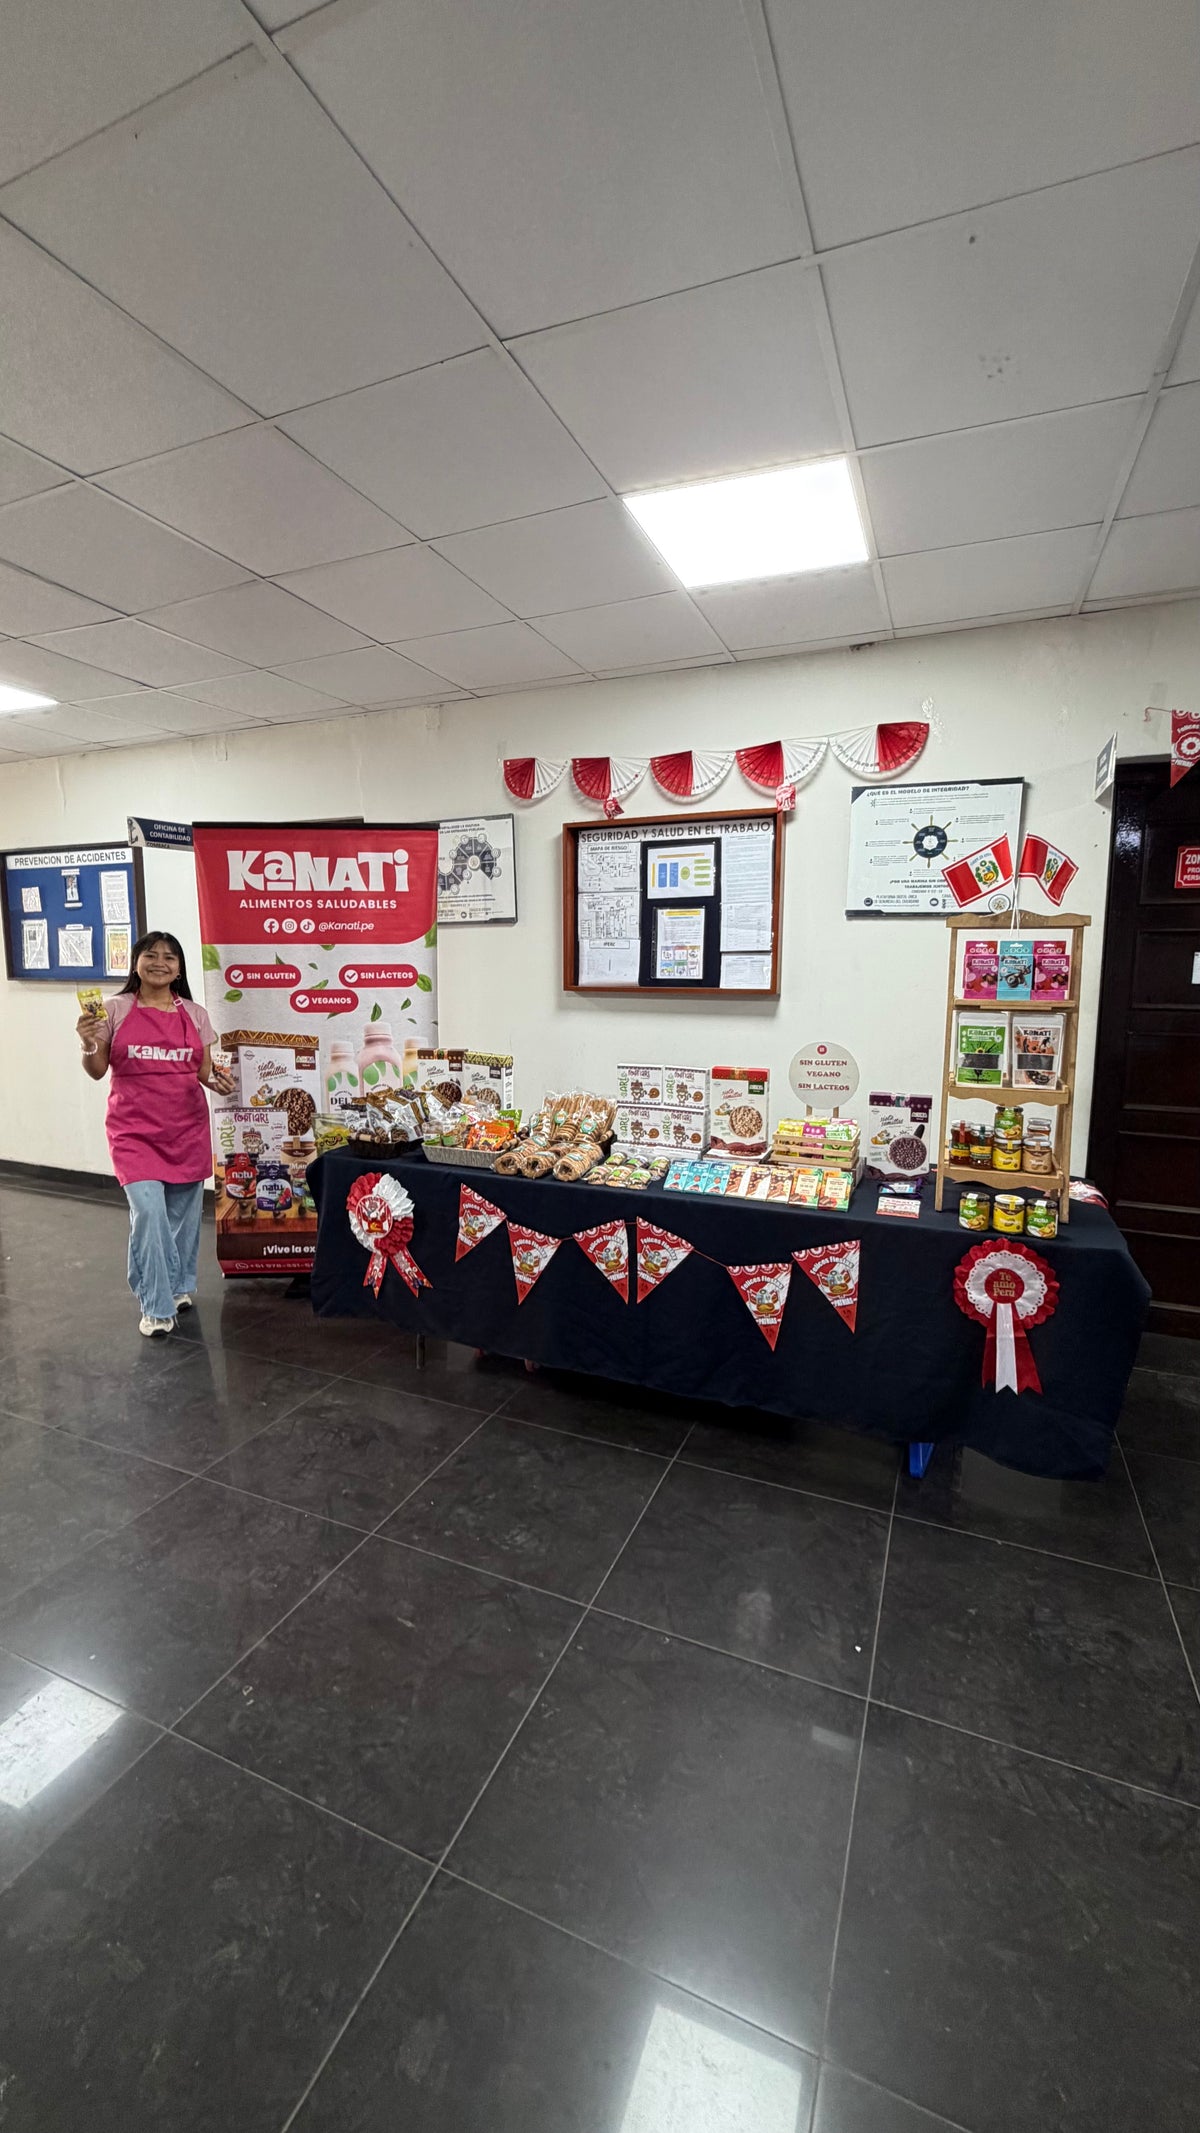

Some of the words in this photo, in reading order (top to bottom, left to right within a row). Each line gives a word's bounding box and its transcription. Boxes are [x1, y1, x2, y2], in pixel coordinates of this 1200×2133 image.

[153, 823, 178, 832] OFICINA
[581, 829, 639, 843] SEGURIDAD
[642, 829, 648, 839] Y
[651, 827, 684, 838] SALUD
[688, 825, 701, 837] EN
[705, 824, 716, 836] EL
[718, 820, 771, 835] TRABAJO
[149, 830, 191, 842] CONTABILIDAD
[14, 854, 62, 867] PREVENCION
[64, 854, 75, 865] DE
[76, 850, 127, 863] ACCIDENTES
[239, 899, 313, 910] ALIMENTOS
[317, 899, 397, 910] SALUDABLES
[318, 920, 375, 933] @Kanati.pe
[246, 972, 261, 981] SIN
[263, 972, 297, 981] GLUTEN
[360, 971, 375, 980] SIN
[376, 968, 414, 980] LÁCTEOS
[311, 996, 352, 1005] VEGANOS
[814, 1083, 849, 1091] LACTEOS
[231, 1170, 254, 1179] natu
[262, 1183, 284, 1192] natu
[263, 1244, 290, 1256] ¡Vive
[291, 1244, 302, 1253] la
[999, 1271, 1012, 1281] Te
[993, 1281, 1016, 1289] amo
